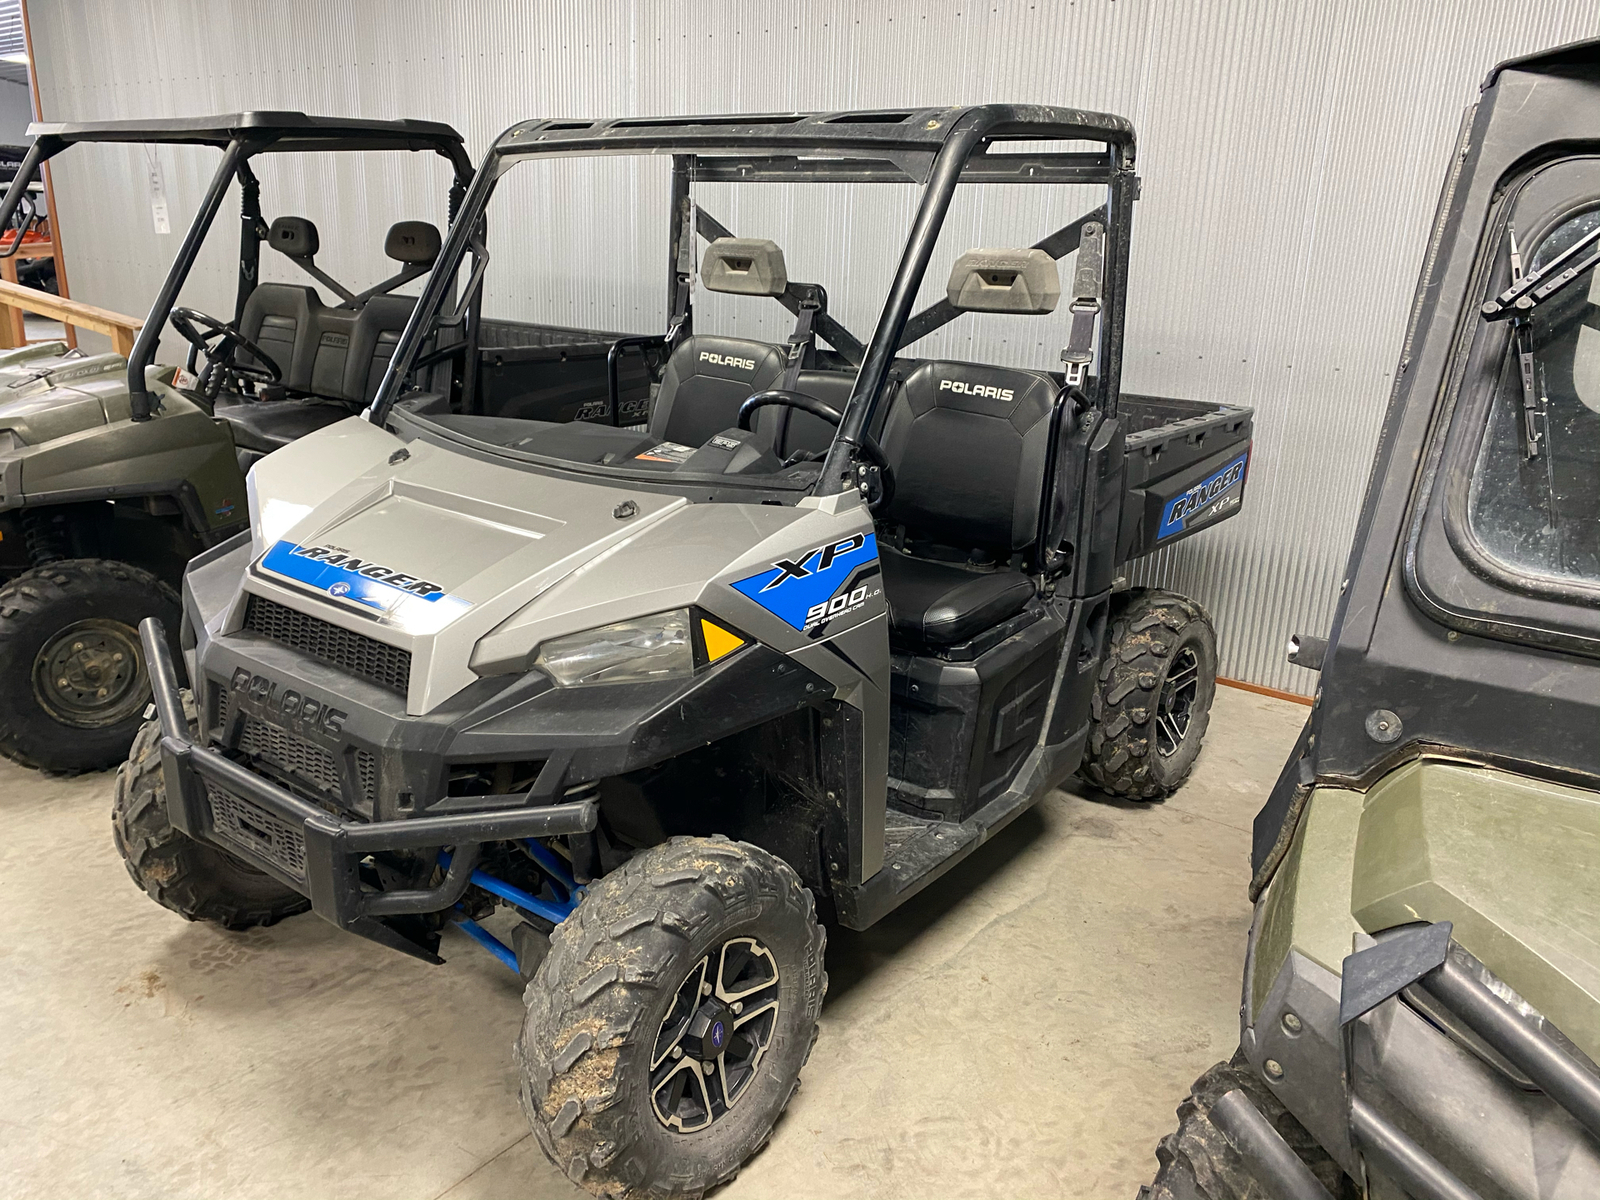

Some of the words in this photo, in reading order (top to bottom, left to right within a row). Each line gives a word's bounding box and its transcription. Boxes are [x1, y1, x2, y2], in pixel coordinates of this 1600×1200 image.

[0, 160, 21, 169] LAR
[699, 351, 756, 371] POLARIS
[940, 379, 1015, 402] POLARIS
[574, 398, 650, 421] RAGE
[1167, 460, 1244, 527] RANGER
[1208, 496, 1230, 517] XP
[295, 546, 444, 597] RANGER
[758, 532, 866, 594] XP
[805, 584, 868, 624] 900
[803, 621, 821, 632] DUAL
[821, 607, 852, 625] OVERHEAD
[230, 666, 349, 742] POLARIS
